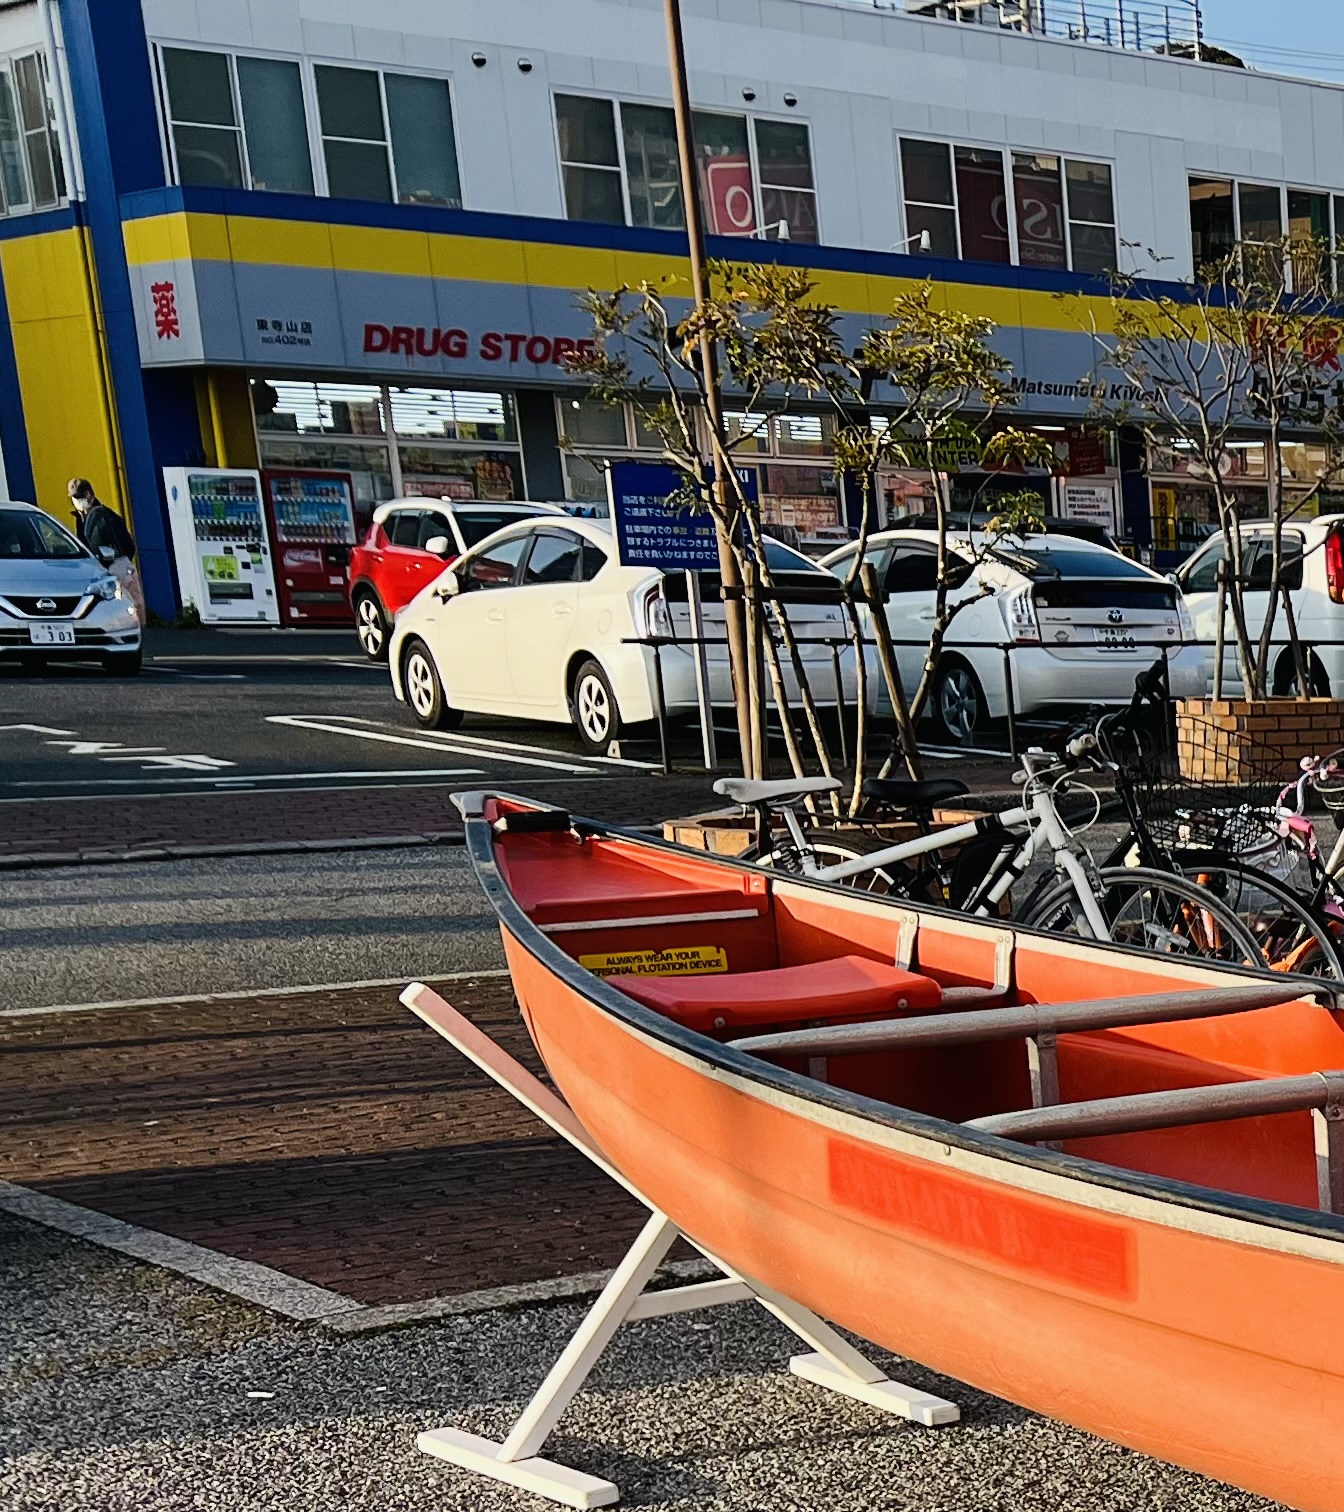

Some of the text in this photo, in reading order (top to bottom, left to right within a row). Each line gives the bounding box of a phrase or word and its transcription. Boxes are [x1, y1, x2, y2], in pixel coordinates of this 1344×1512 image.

[151, 281, 180, 340] 薬
[363, 323, 468, 358] DRUG
[911, 447, 979, 465] WNTER
[606, 951, 700, 966] ALWAYS WEAR YOUR
[637, 961, 688, 973] FLOTATION
[689, 959, 722, 970] DEVICE
